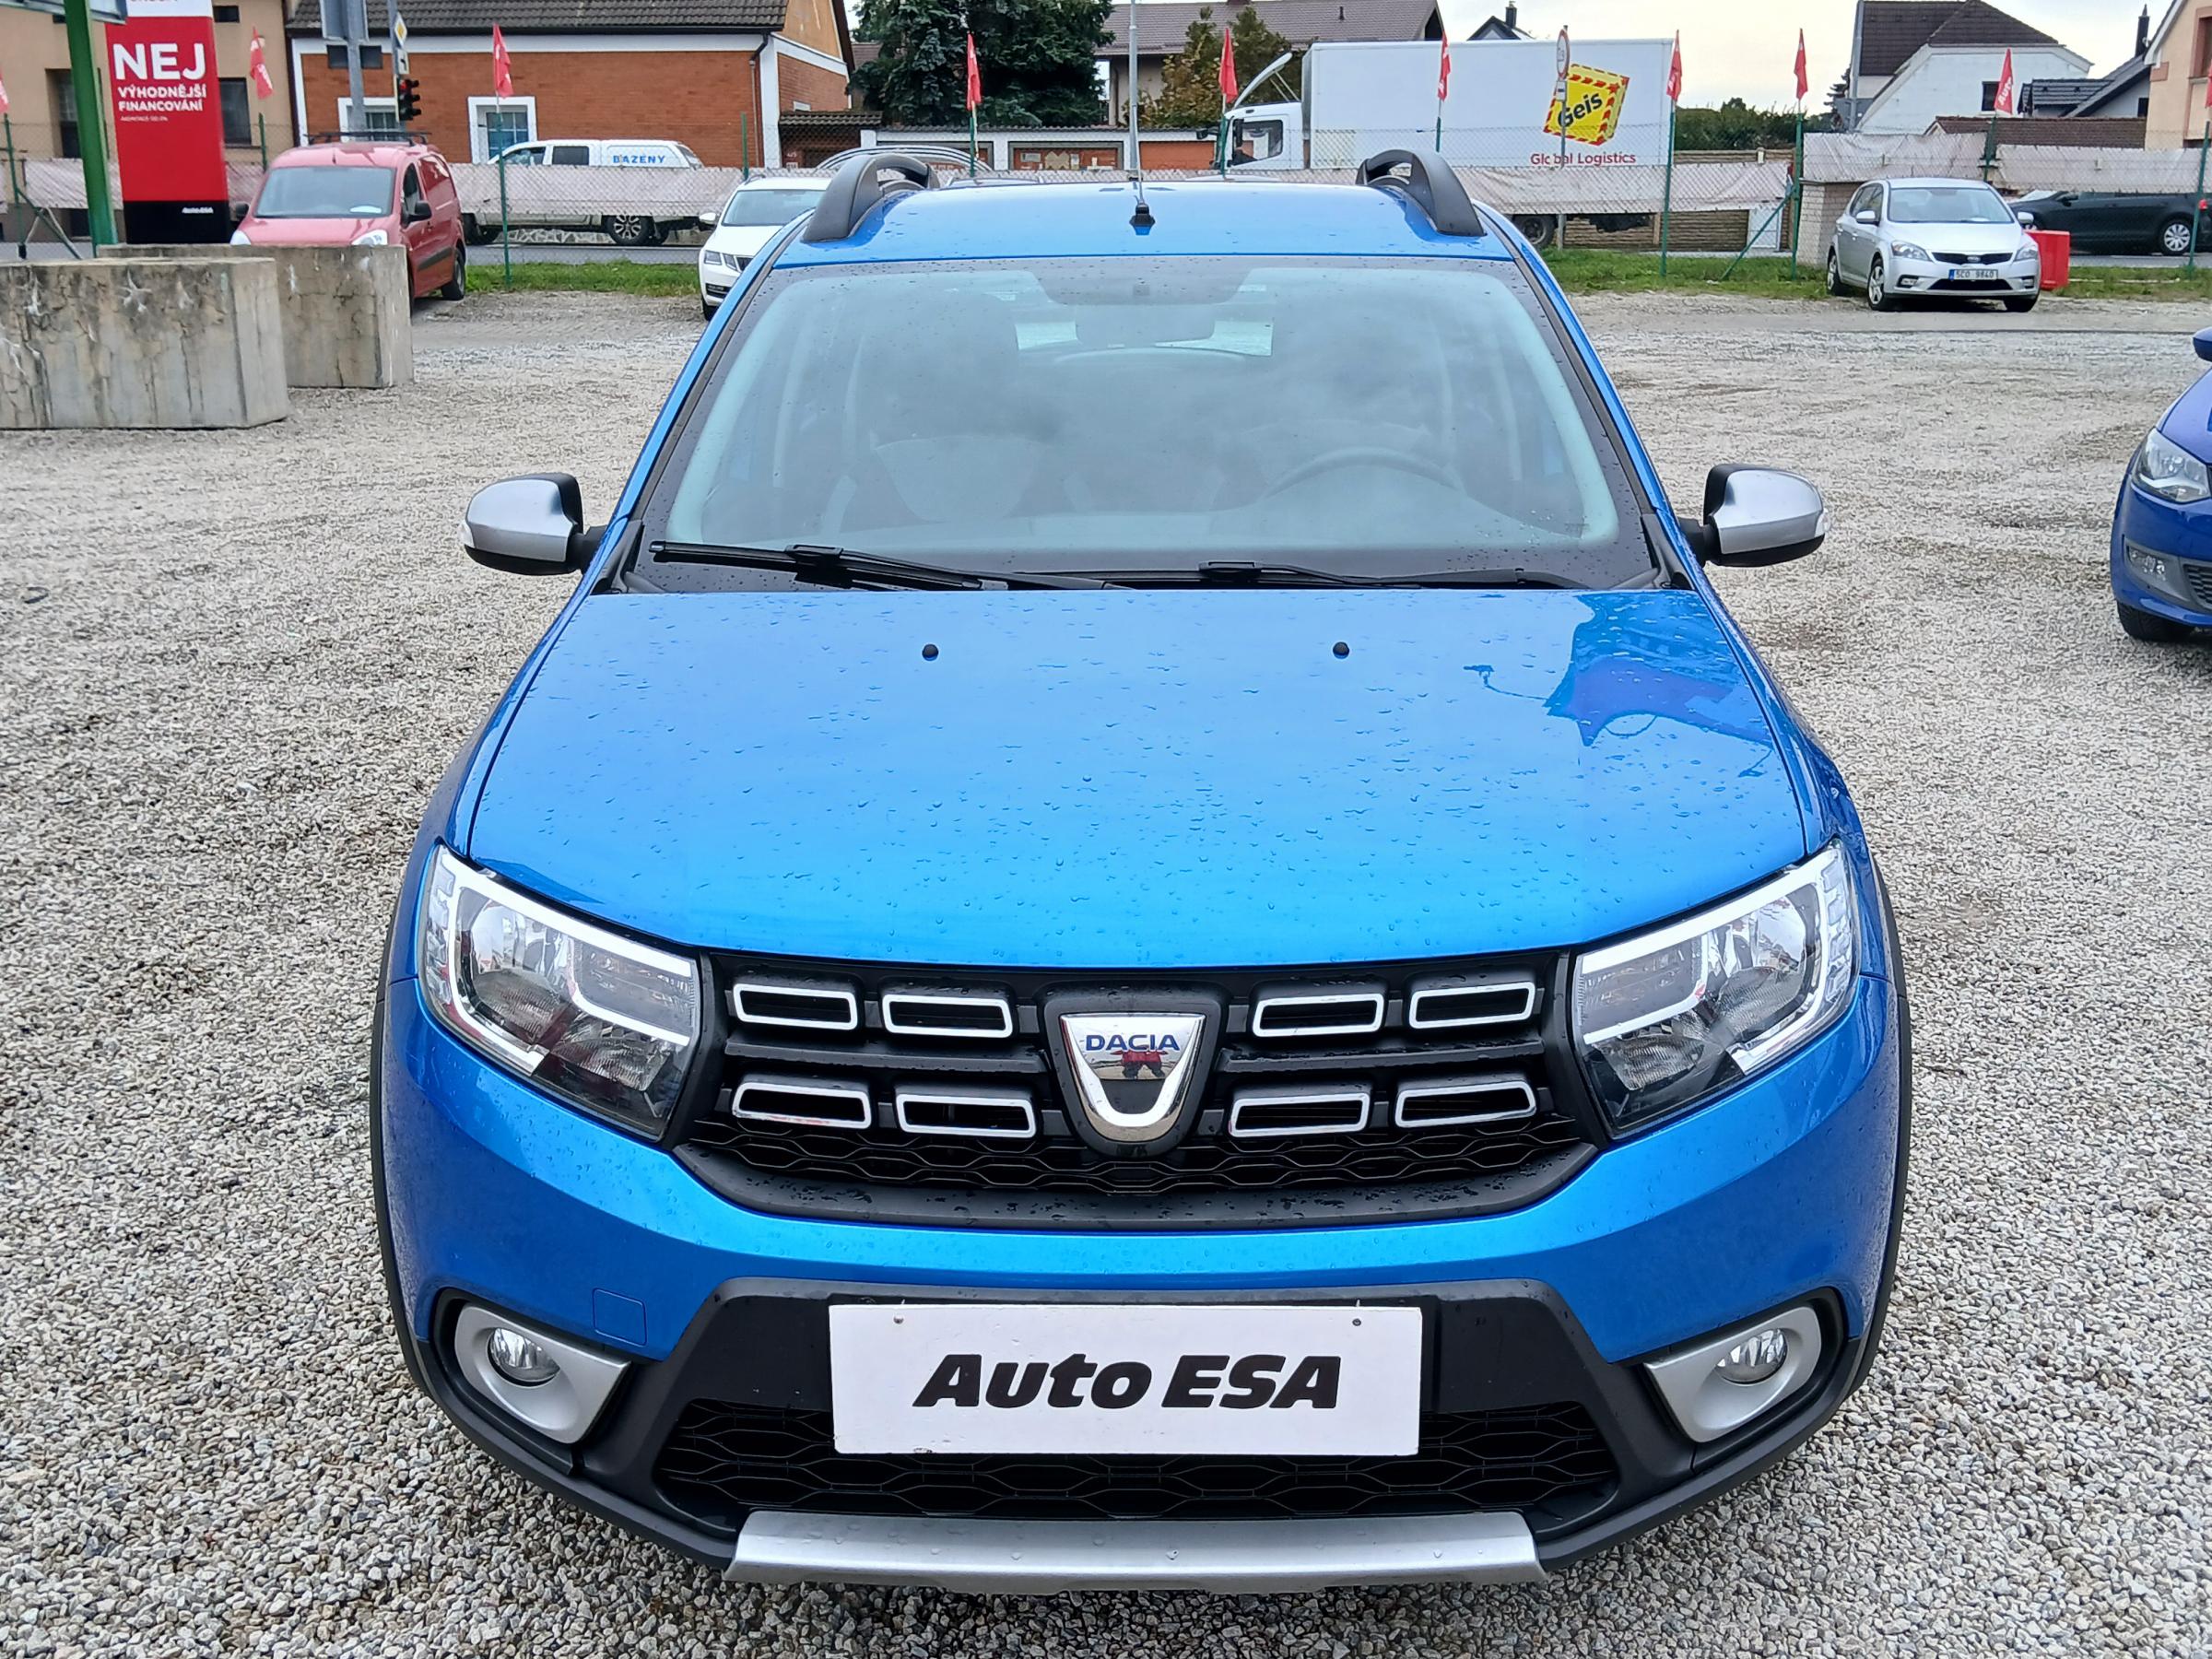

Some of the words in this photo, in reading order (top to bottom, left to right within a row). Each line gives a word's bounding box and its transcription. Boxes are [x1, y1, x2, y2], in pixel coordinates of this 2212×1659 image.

[113, 42, 206, 80] NEJ
[117, 84, 207, 99] VÝHODNĚJŠÍ
[118, 100, 203, 112] FINANCOVÁNÍ
[1558, 92, 1603, 127] Geis
[1577, 151, 1637, 167] Logistics
[1086, 1034, 1180, 1051] DACIA
[912, 1353, 1152, 1409] Auto
[1161, 1354, 1342, 1409] ESA
